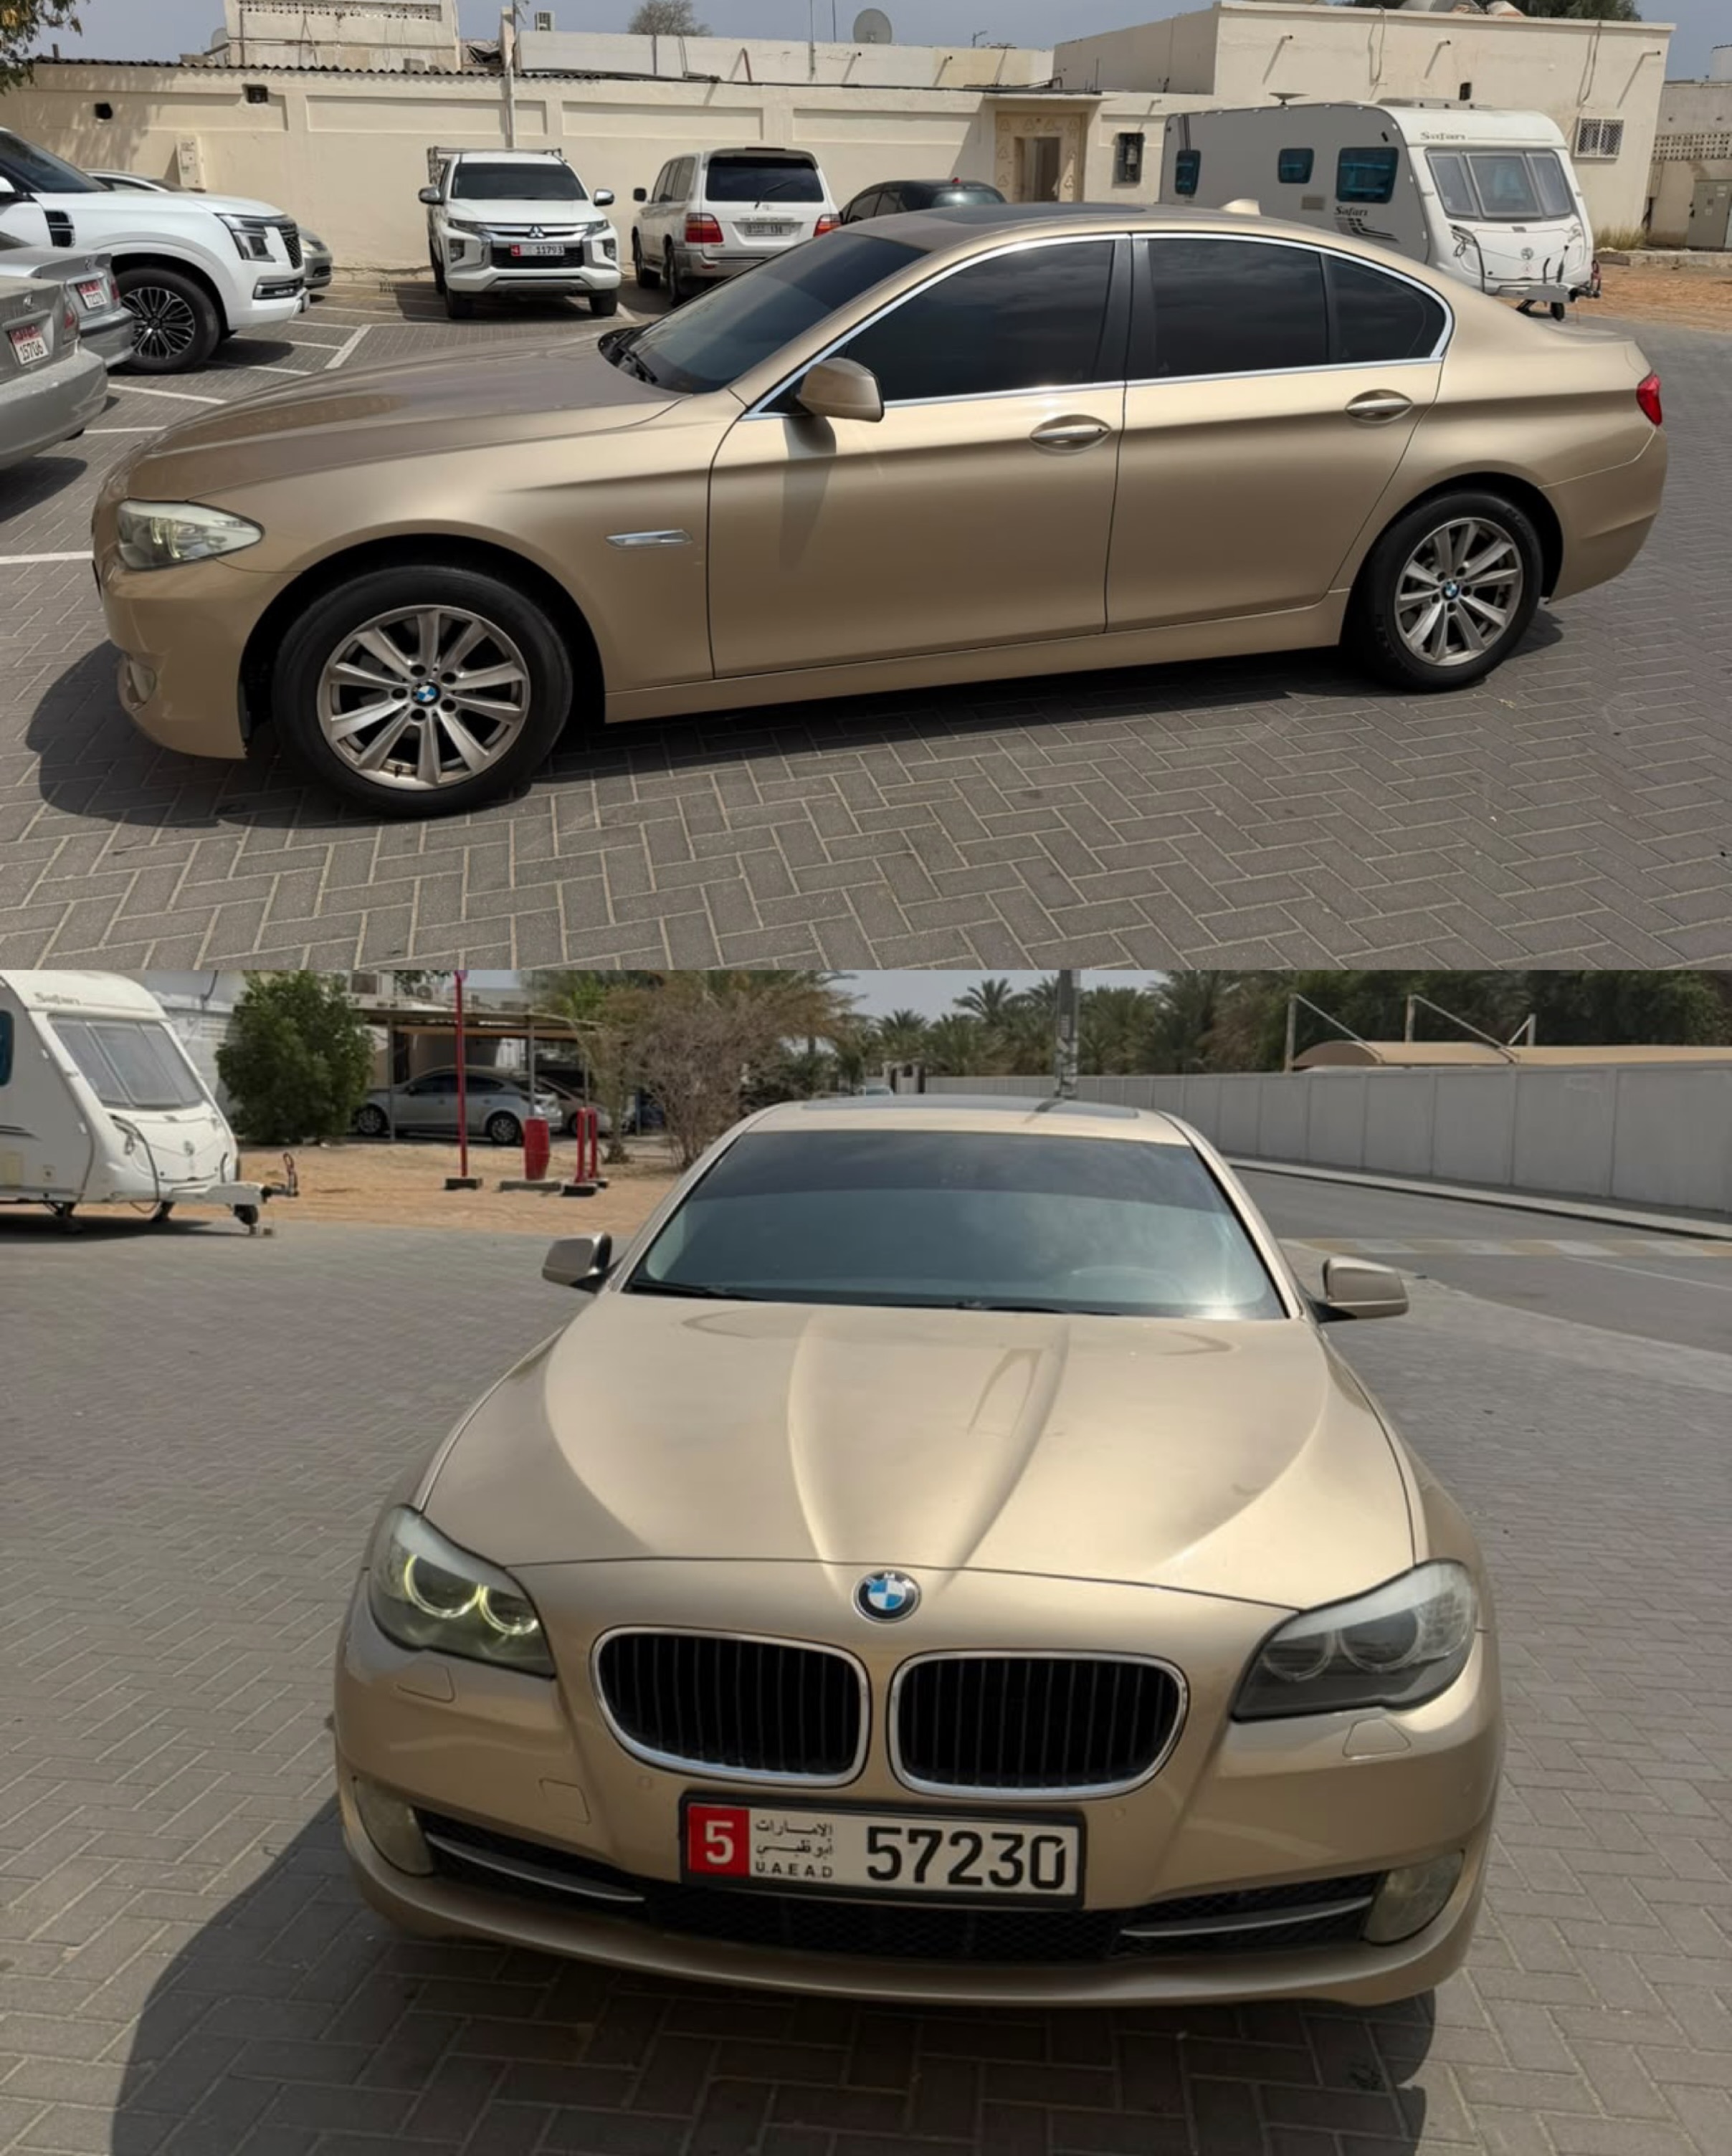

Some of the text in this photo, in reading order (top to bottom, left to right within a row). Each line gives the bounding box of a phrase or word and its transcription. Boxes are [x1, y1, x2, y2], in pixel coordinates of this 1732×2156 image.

[1334, 206, 1368, 216] Safari
[706, 1821, 734, 1864] 5
[867, 1825, 1066, 1890] 57230
